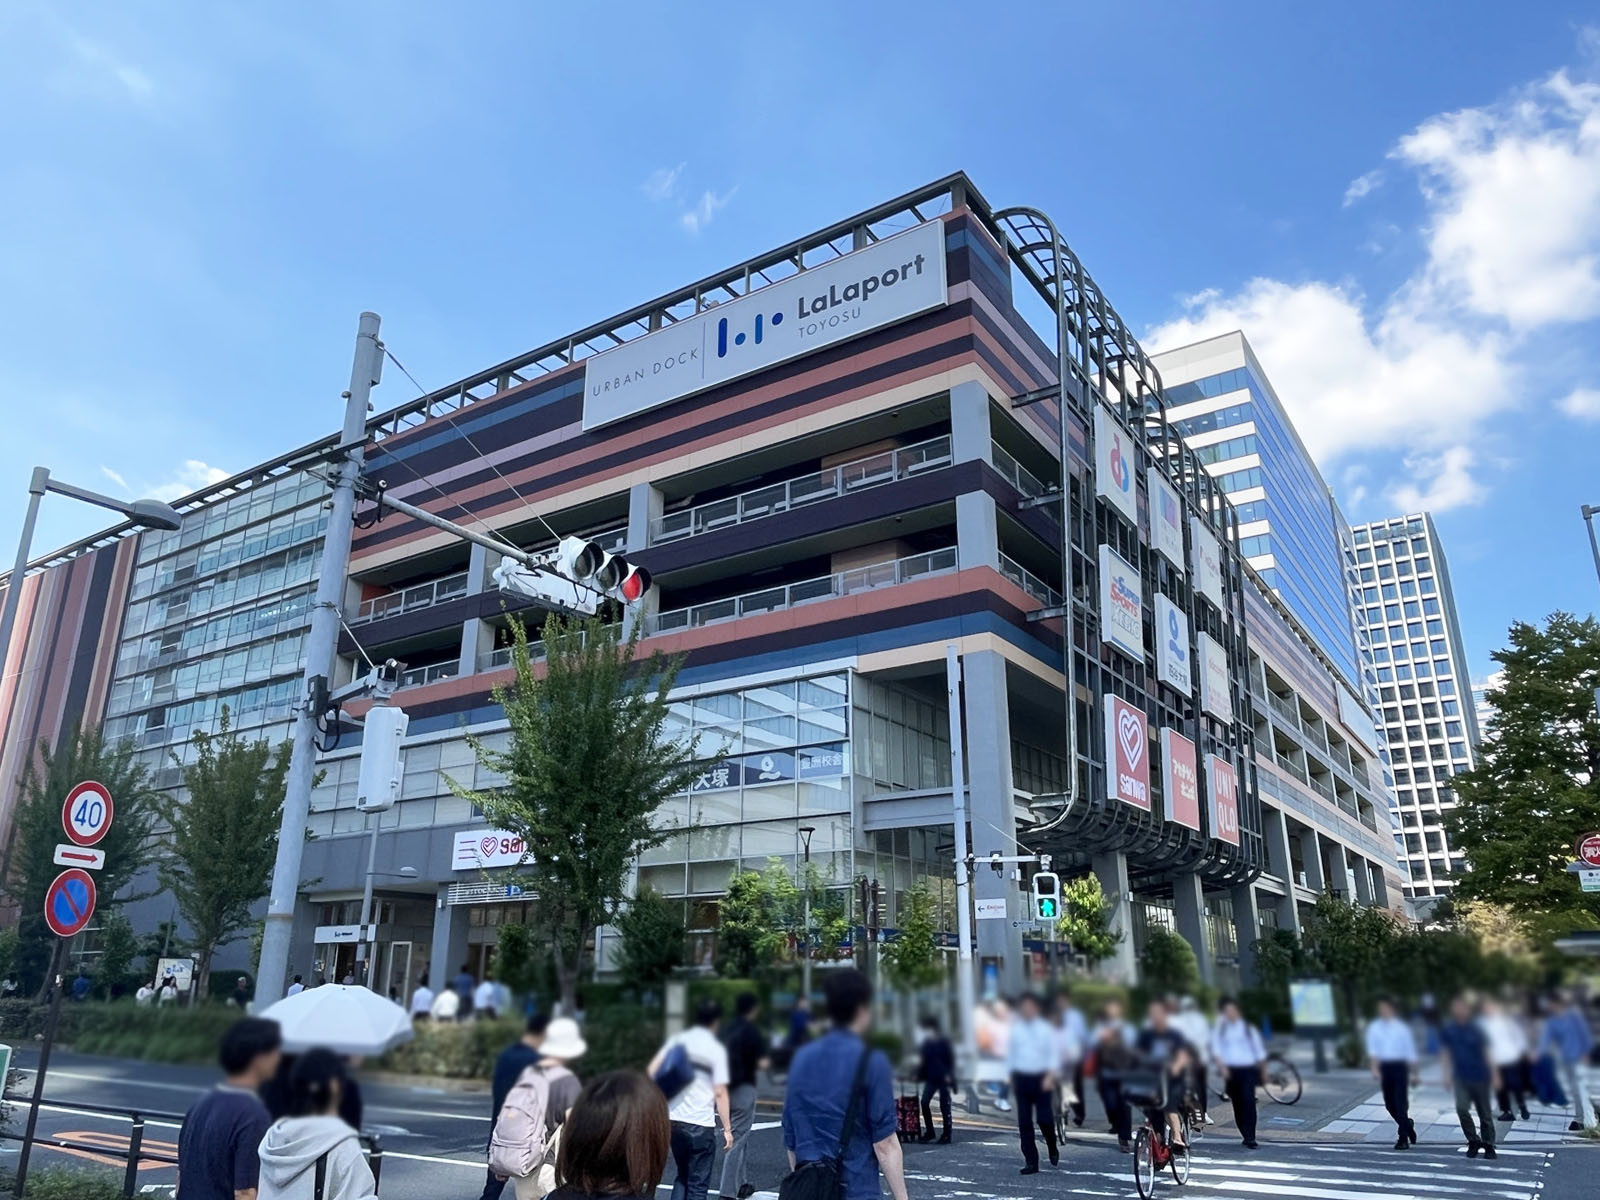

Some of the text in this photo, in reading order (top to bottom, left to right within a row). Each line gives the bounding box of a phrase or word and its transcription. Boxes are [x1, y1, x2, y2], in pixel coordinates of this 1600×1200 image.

[798, 254, 925, 320] LaLaport
[798, 307, 861, 339] TOYOSU
[592, 348, 699, 397] URBAN DOCK
[1215, 768, 1233, 800] UNI
[74, 799, 103, 828] 40
